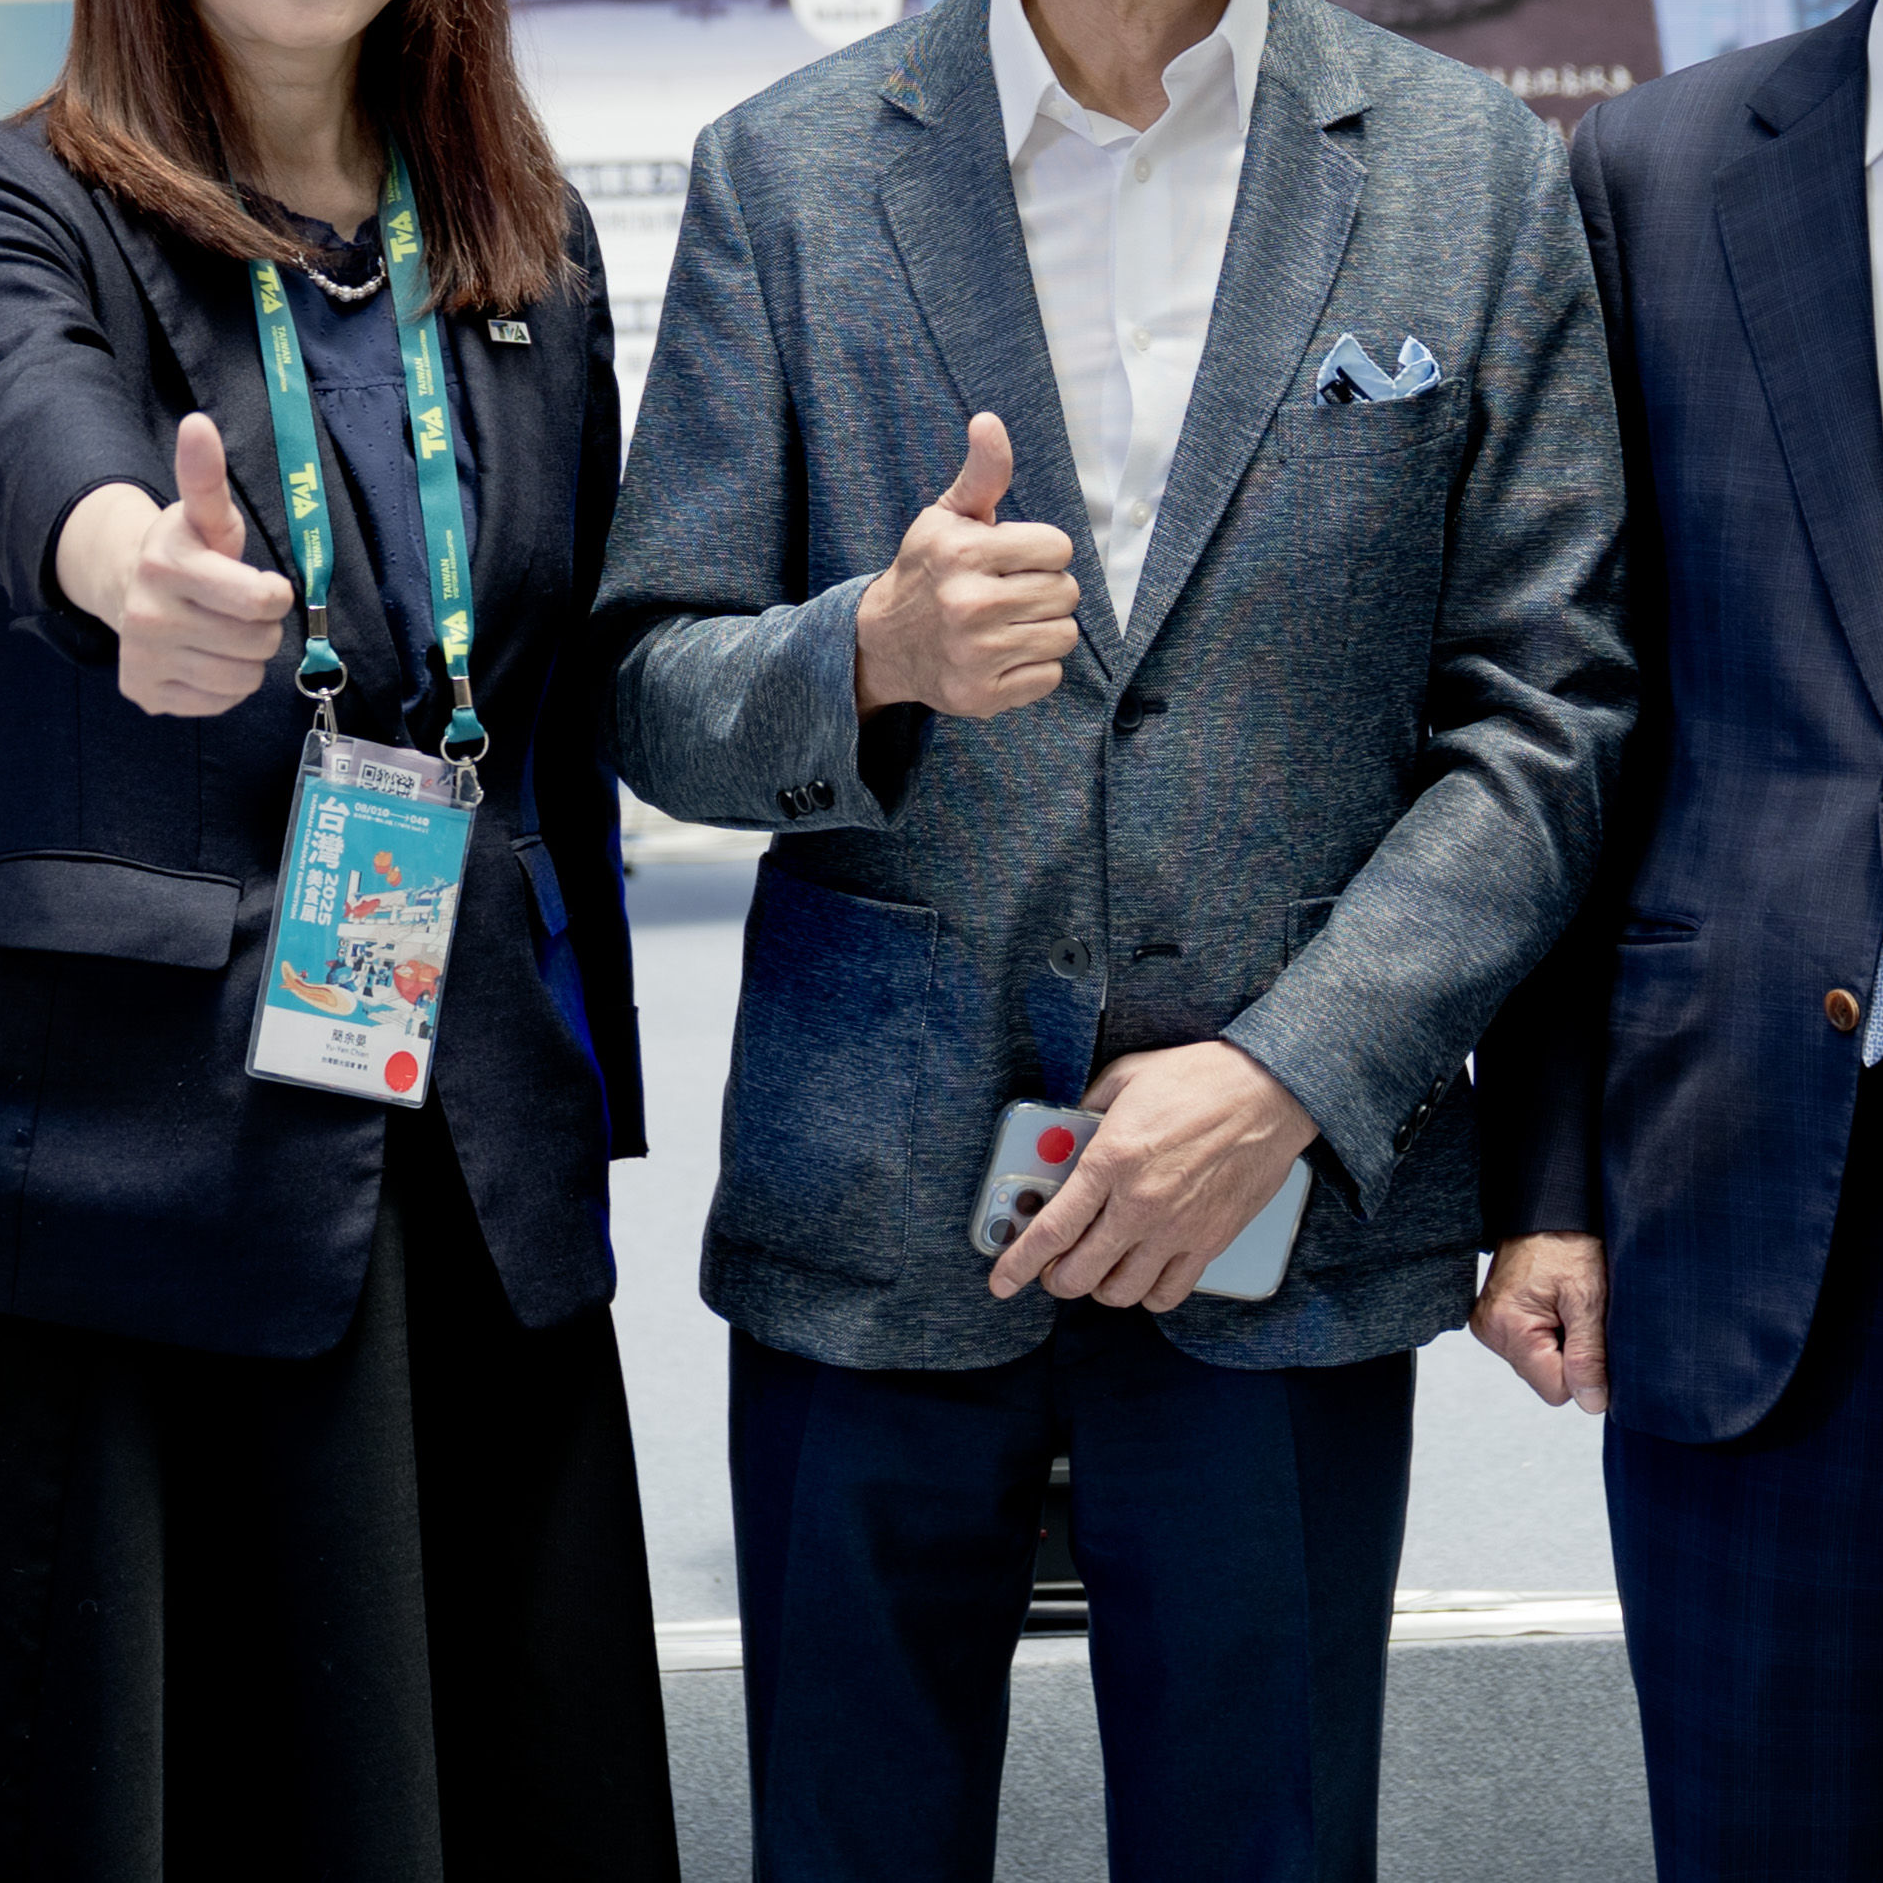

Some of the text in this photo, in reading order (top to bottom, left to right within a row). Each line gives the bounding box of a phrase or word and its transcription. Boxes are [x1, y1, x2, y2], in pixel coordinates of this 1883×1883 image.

[277, 325, 293, 365] TAIWAN
[414, 357, 427, 396] TAIWAN
[310, 527, 323, 567] TAIWAN
[440, 558, 453, 601] TAIWAN
[308, 794, 318, 826] TAIWAN
[309, 797, 350, 869] 台灣
[318, 873, 339, 926] 2025
